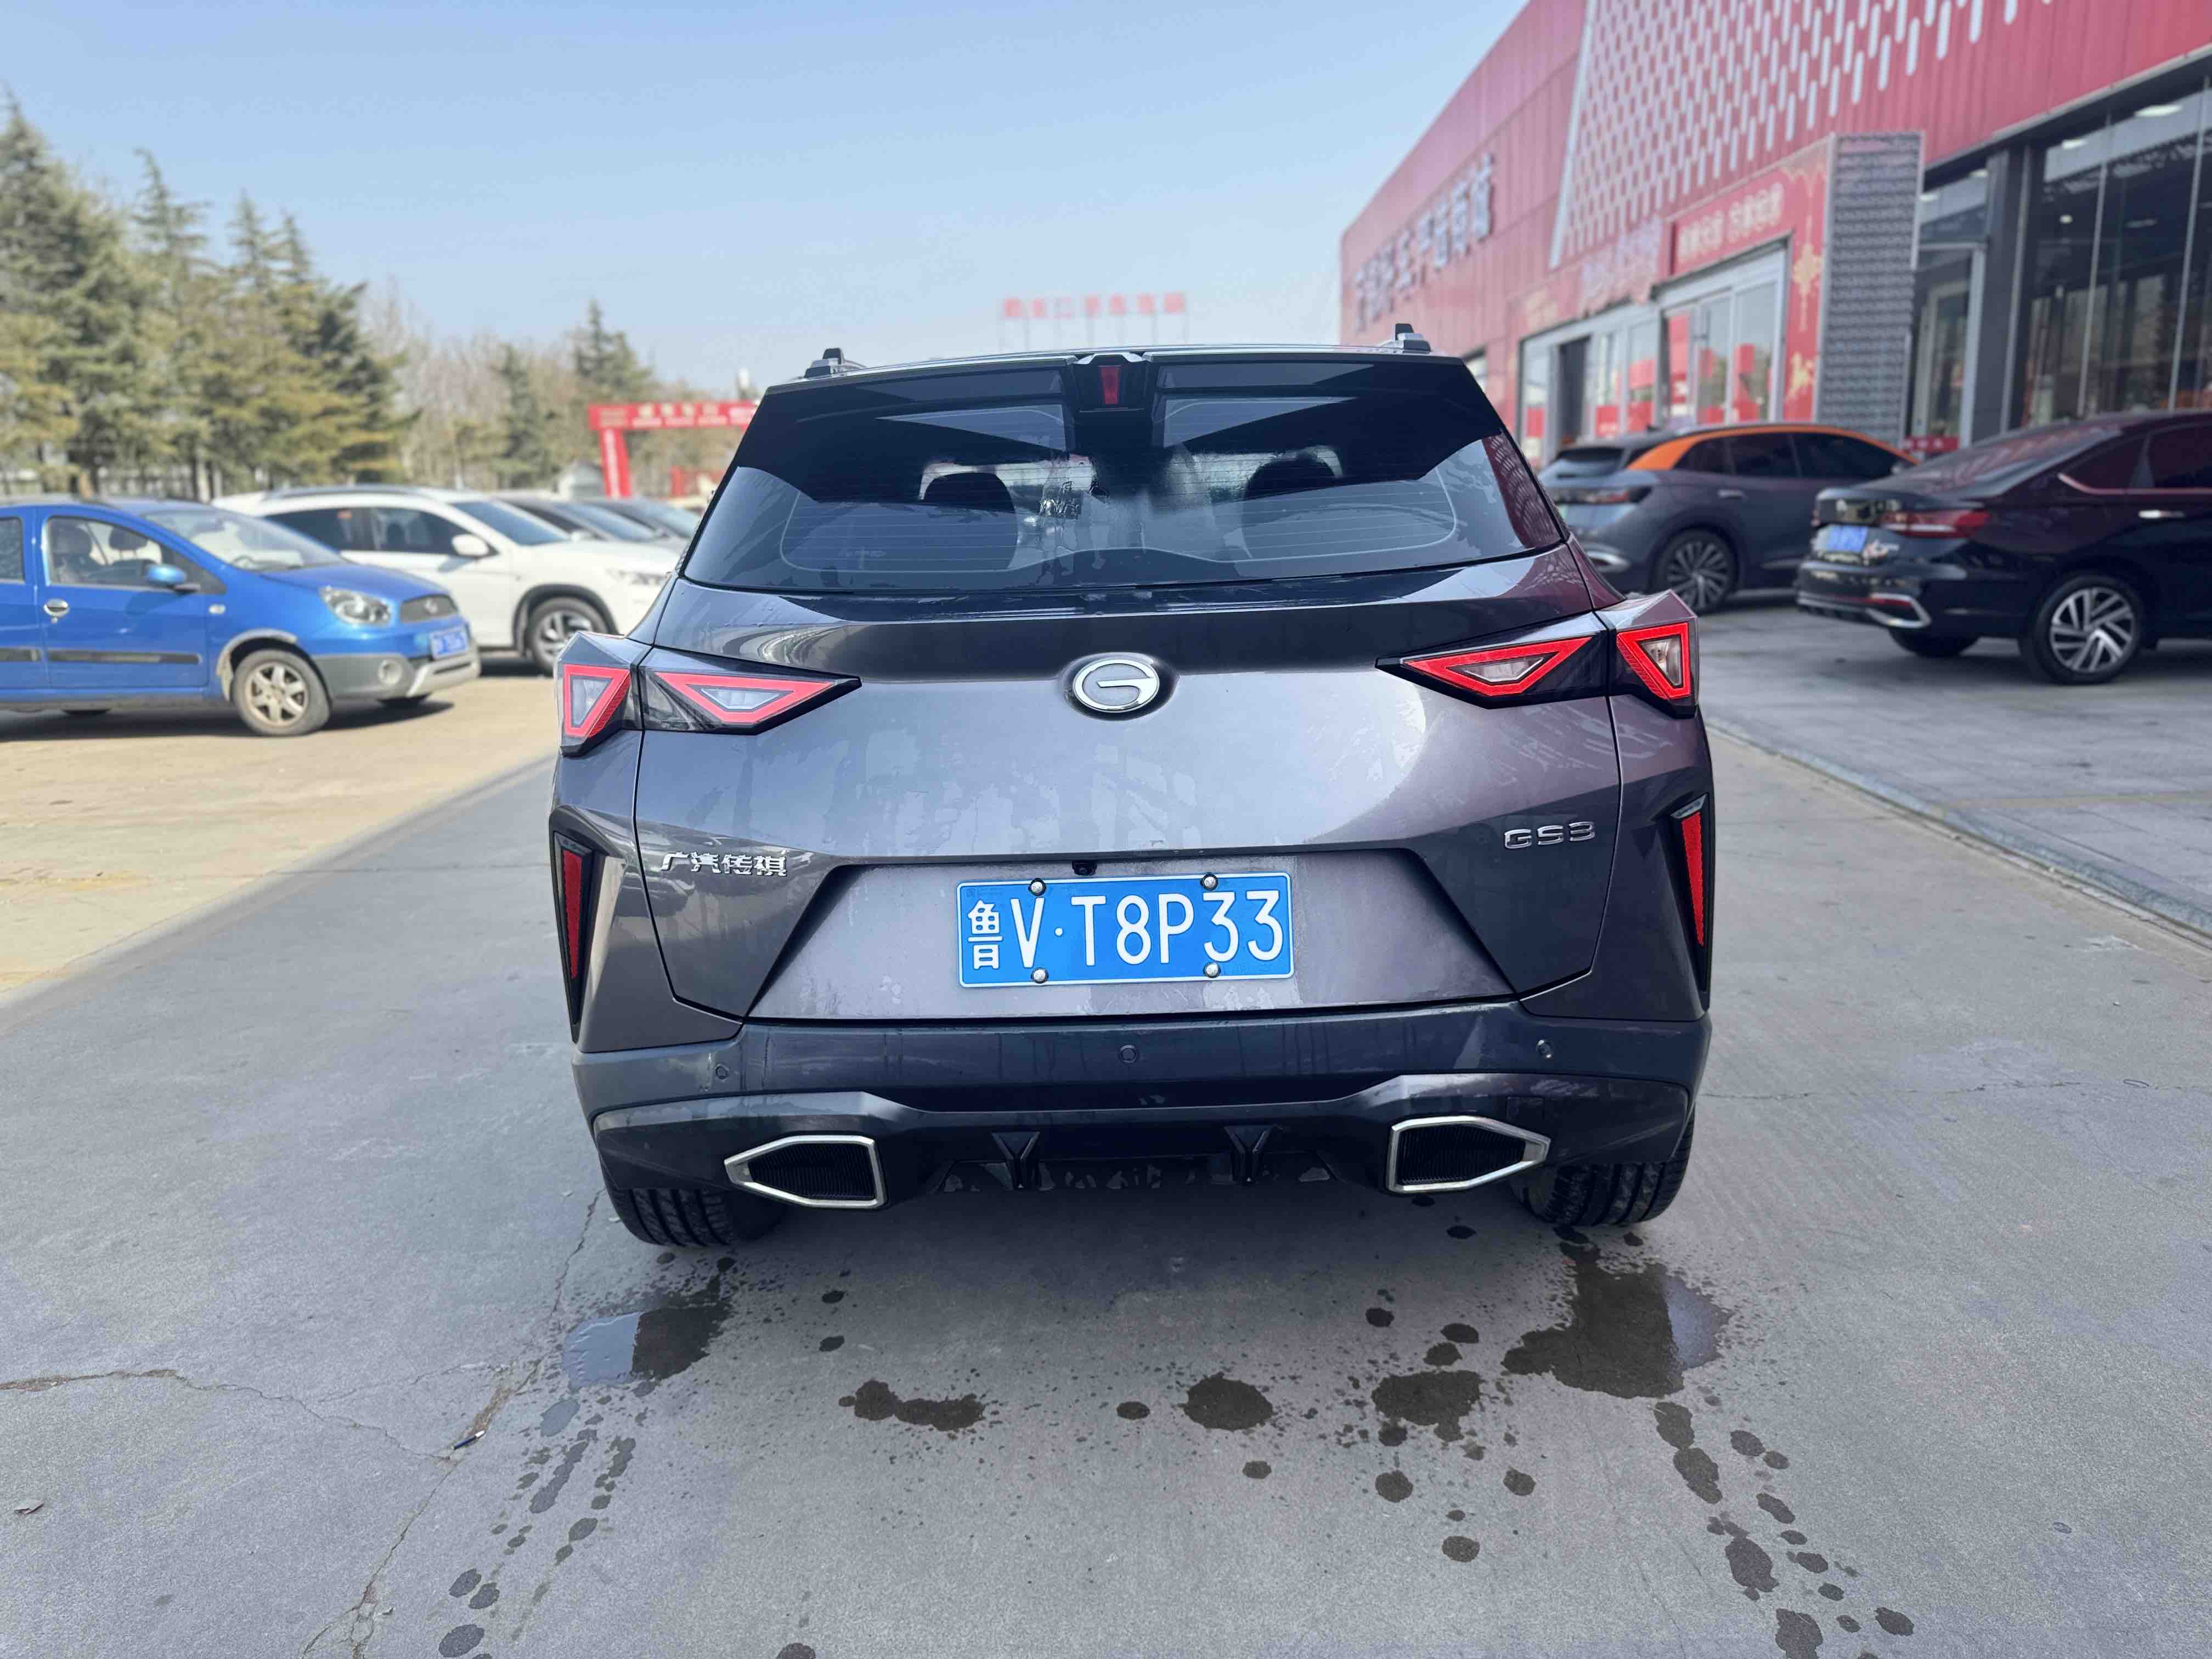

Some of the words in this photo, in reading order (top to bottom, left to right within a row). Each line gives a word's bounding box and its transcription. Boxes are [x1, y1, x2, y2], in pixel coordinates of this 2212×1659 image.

[1504, 821, 1595, 849] GS3
[661, 851, 788, 877] 广汽传祺
